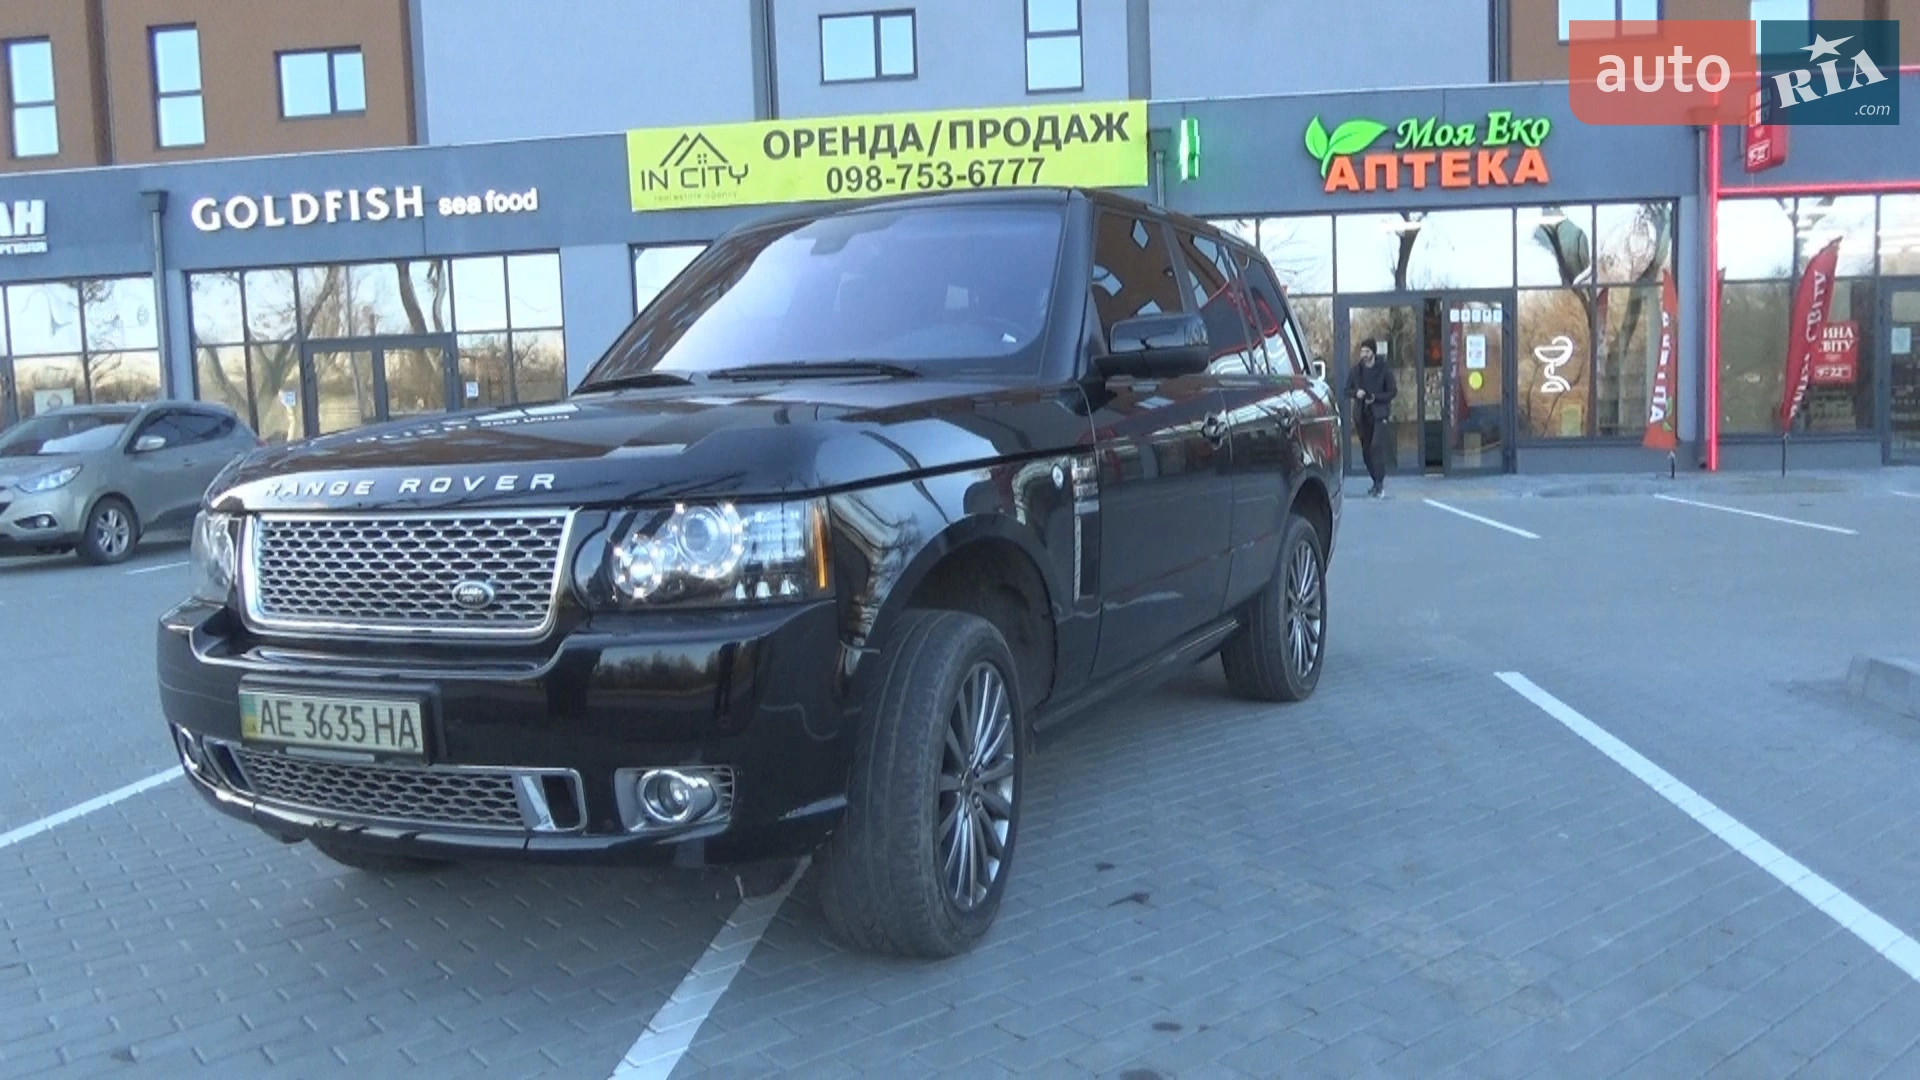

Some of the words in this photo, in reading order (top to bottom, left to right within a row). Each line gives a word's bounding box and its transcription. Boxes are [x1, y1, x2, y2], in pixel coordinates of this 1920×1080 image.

[763, 112, 1130, 160] ОРЕНДА/ПРОДАЖ
[1395, 116, 1476, 149] Моя
[1482, 110, 1551, 148] Еко
[641, 169, 668, 191] IN
[680, 164, 749, 188] CITY
[826, 157, 1046, 194] 098-753-6777
[1324, 148, 1549, 192] АПТЕКА
[191, 185, 424, 232] GOLDFISH
[438, 196, 482, 216] sea
[486, 188, 537, 213] food
[266, 480, 376, 497] RANGE
[398, 473, 556, 494] ROVER
[260, 700, 295, 738] AE
[303, 702, 366, 743] 3635
[372, 707, 419, 748] HA
